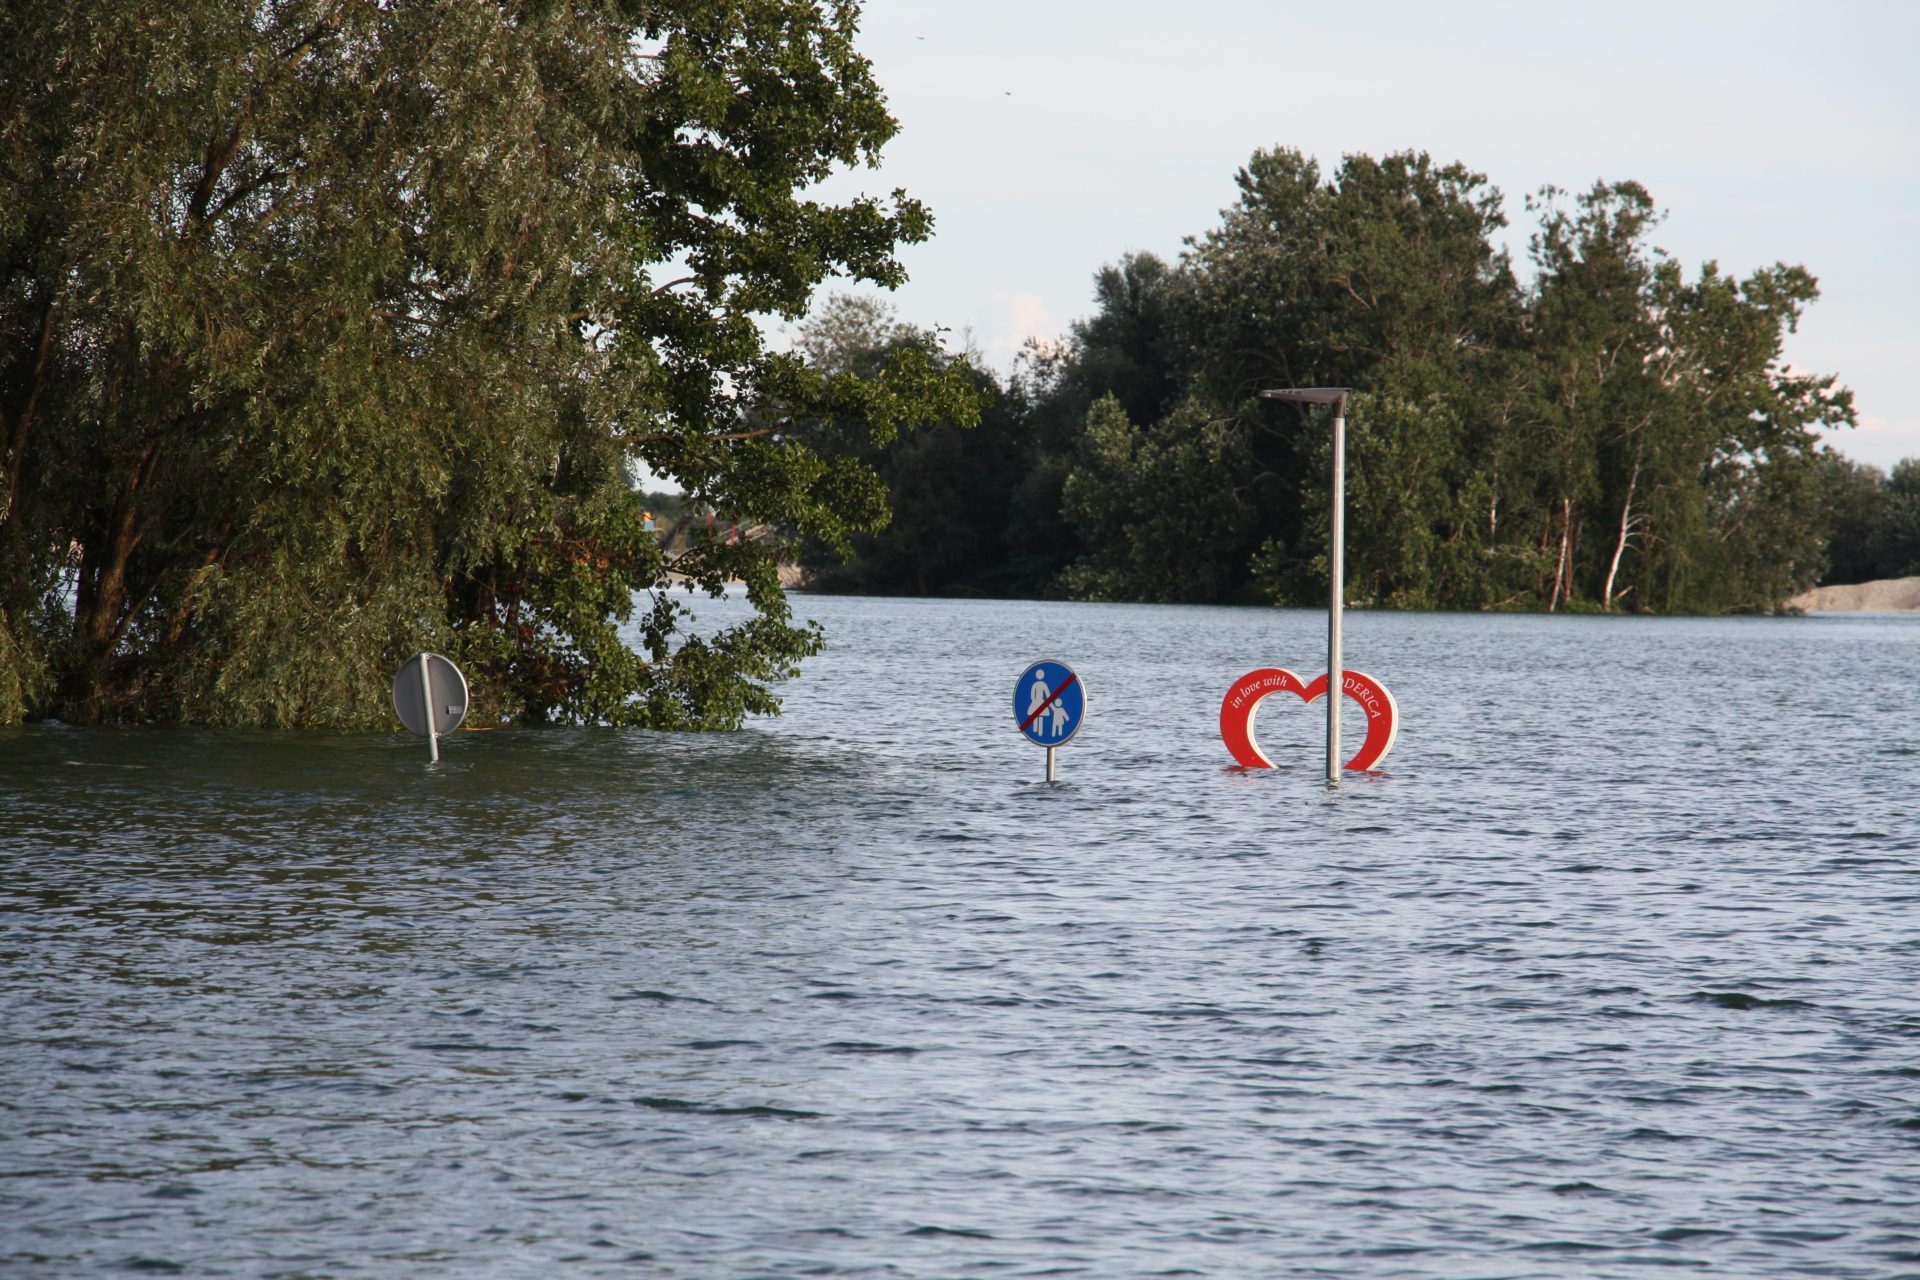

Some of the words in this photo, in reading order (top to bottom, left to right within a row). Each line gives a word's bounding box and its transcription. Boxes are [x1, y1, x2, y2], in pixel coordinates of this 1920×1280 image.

[1230, 696, 1242, 709] in
[1240, 680, 1261, 698] love
[1263, 674, 1287, 687] with
[1340, 677, 1382, 719] DERICA
